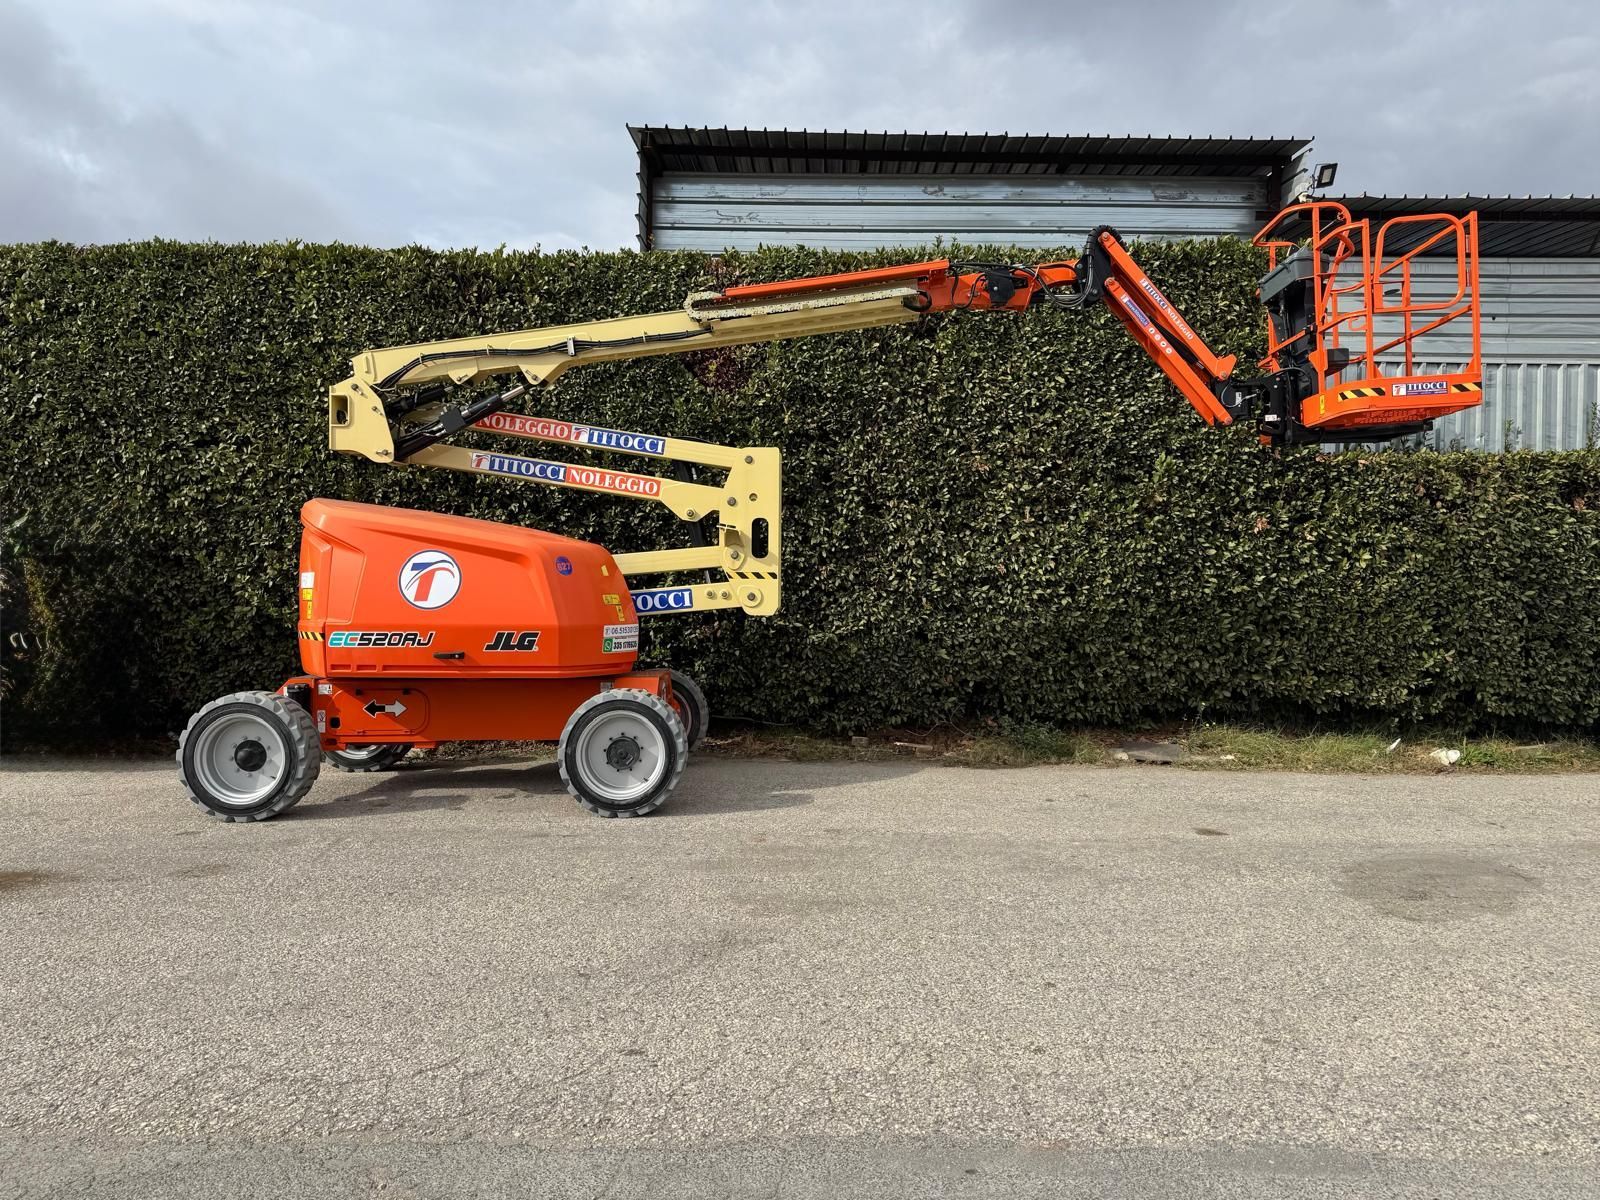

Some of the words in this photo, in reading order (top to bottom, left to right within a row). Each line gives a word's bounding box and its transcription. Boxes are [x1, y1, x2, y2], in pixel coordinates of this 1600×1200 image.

[1167, 308, 1194, 340] NOLEGGIO
[1407, 381, 1447, 391] TITOCCI
[479, 415, 569, 438] NOLEGGIO
[589, 430, 665, 454] TITOCCI
[491, 456, 566, 481] TITOCCI
[569, 469, 659, 495] NOLEGGIO
[329, 632, 434, 647] EC520AJ
[484, 631, 539, 651] JLG
